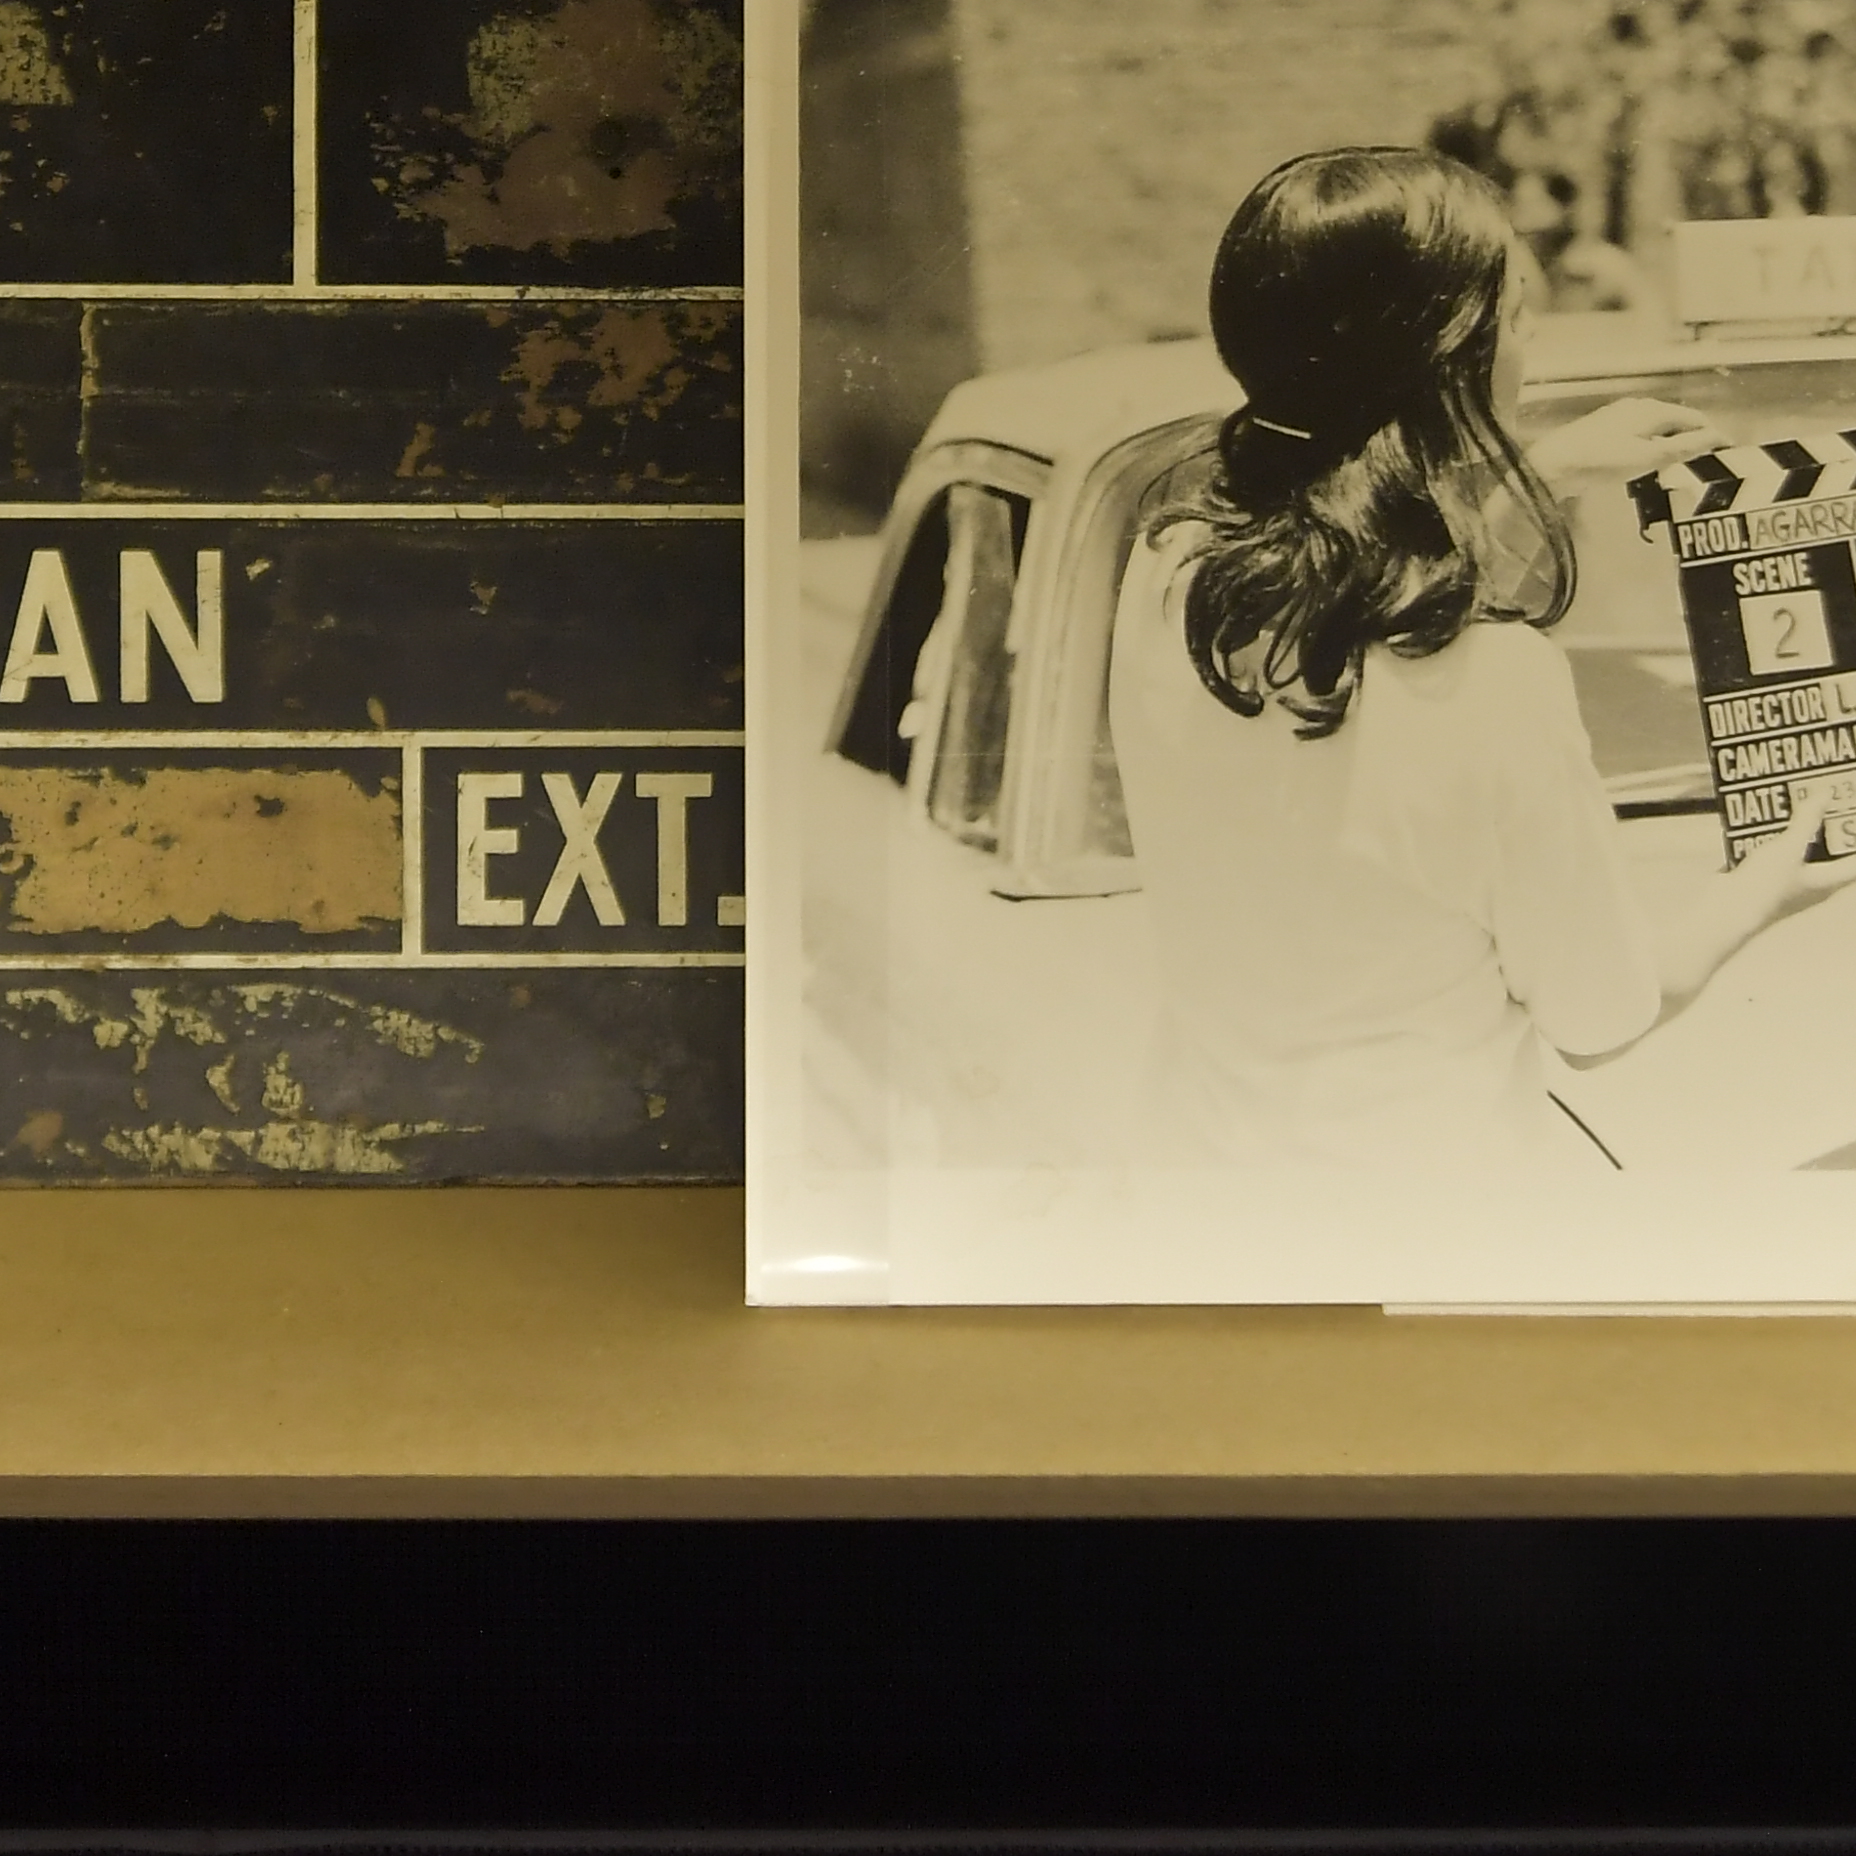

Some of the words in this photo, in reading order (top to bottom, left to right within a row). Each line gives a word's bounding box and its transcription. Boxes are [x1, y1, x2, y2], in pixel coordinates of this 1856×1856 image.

[1678, 516, 1749, 559] PROD.
[1732, 551, 1812, 596] SCENE
[1772, 607, 1801, 660] 2
[1707, 686, 1827, 739] DIRECTOR
[1724, 785, 1790, 828] DATE
[456, 772, 746, 927] EXT.
